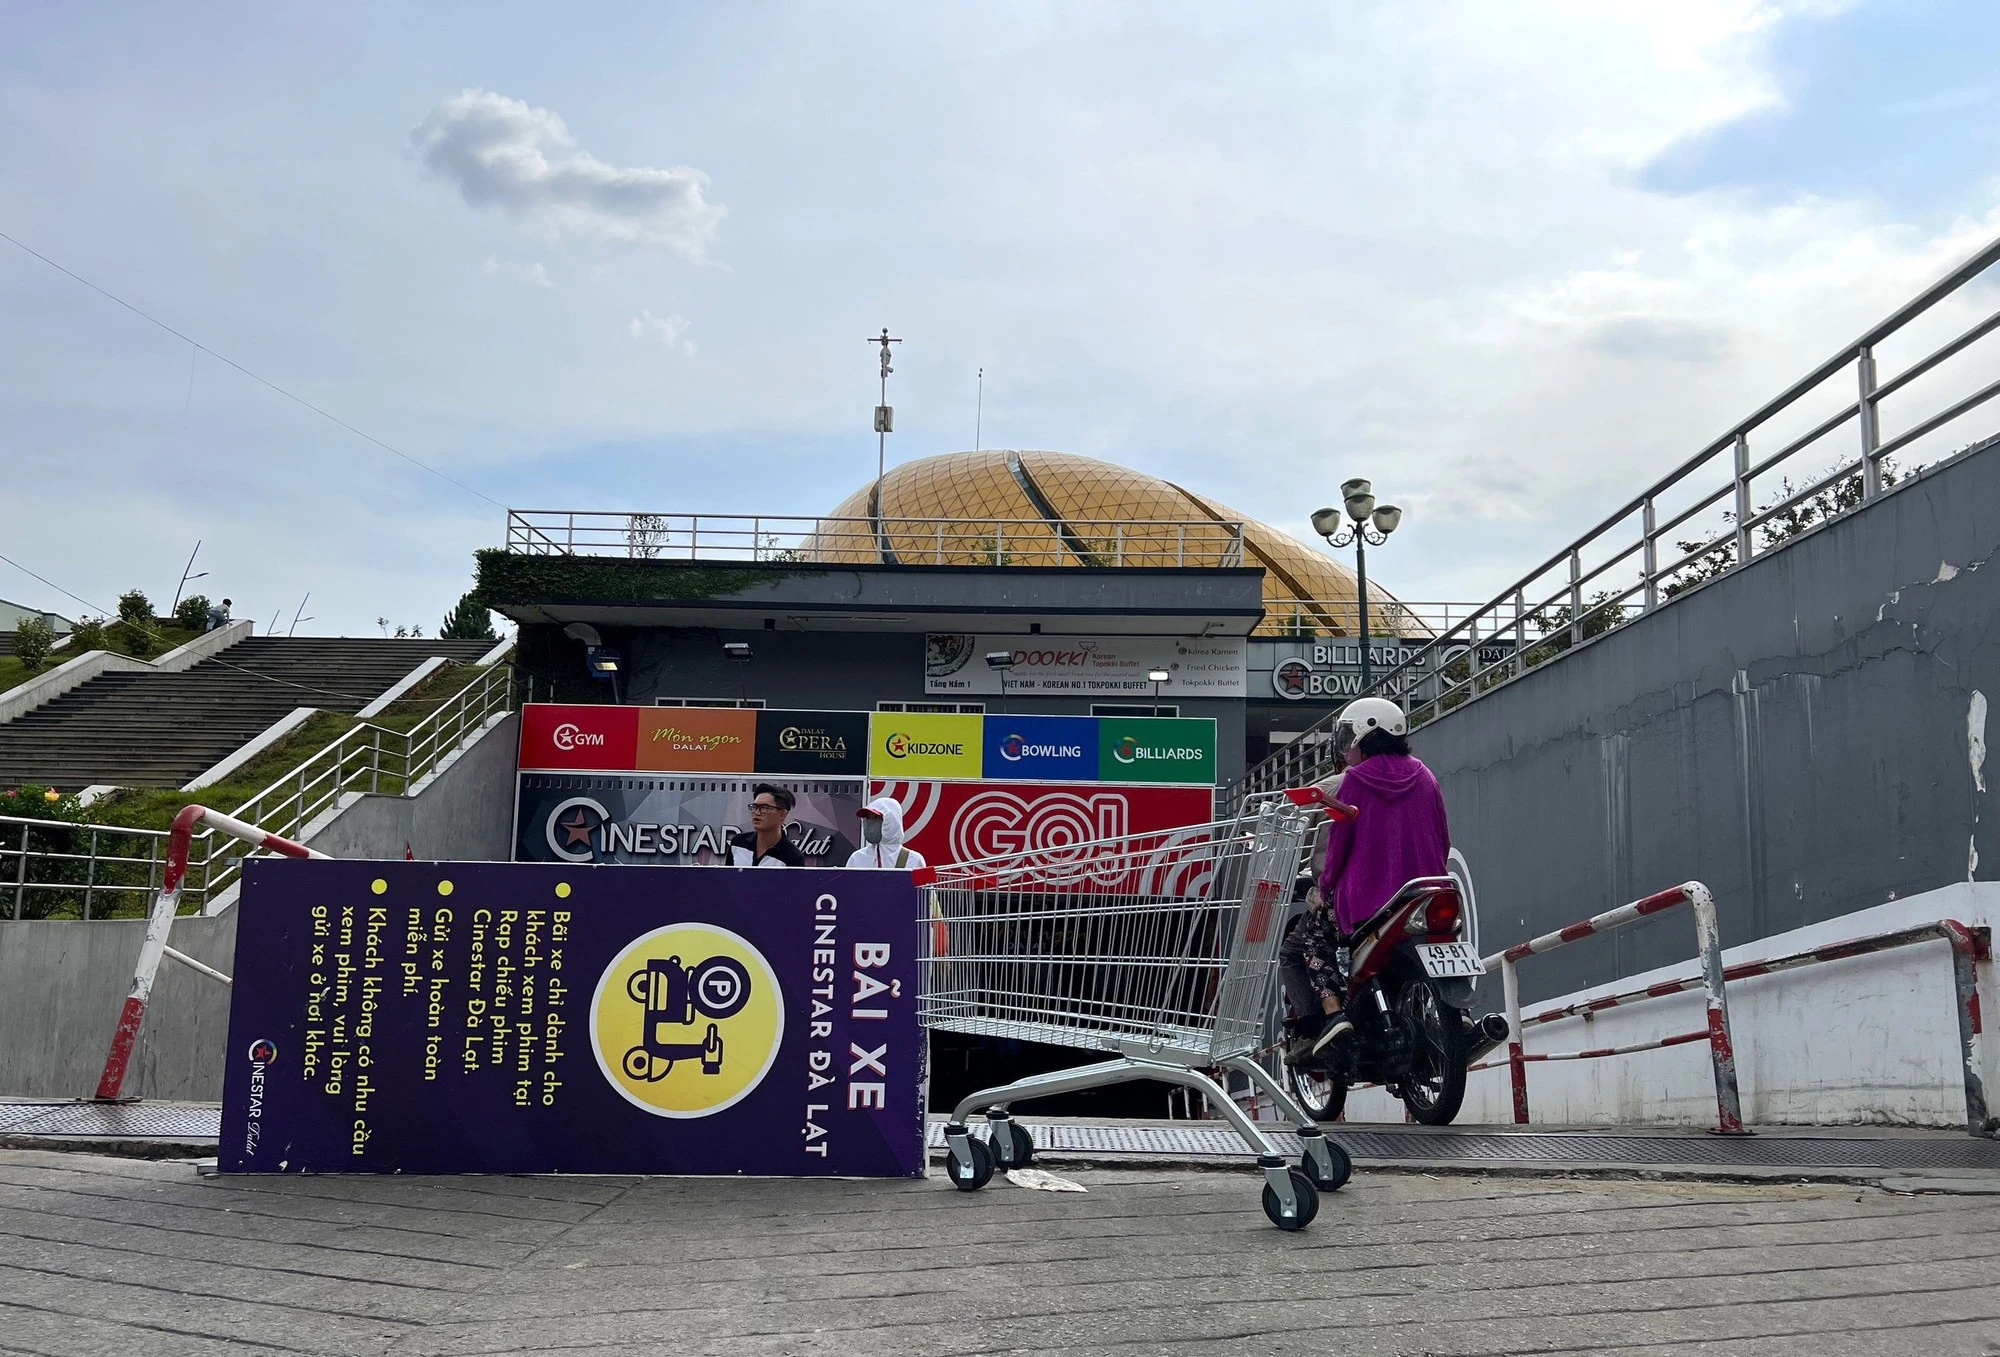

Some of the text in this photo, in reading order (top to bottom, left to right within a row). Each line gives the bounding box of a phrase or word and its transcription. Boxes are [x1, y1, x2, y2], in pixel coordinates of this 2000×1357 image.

[1012, 650, 1087, 668] DOOKKI
[1120, 660, 1140, 668] Buffet
[1188, 648, 1209, 656] Korea
[1004, 680, 1018, 689] VIET
[1020, 680, 1035, 689] NAM
[1042, 680, 1069, 689] KOREAN
[1071, 681, 1086, 689] NO.1
[1088, 681, 1121, 690] TOKPOKKI
[1123, 681, 1147, 690] BUFFET
[1181, 679, 1240, 688] Tokpokki Buffet
[673, 743, 708, 751] DALAT
[699, 735, 743, 751] ngon
[1021, 745, 1081, 758] BOWLING
[1135, 747, 1203, 760] BILLIARDS
[950, 791, 1128, 886] GO!
[401, 907, 428, 998] miễn phí.
[1428, 946, 1469, 959] 49-B1
[1429, 960, 1481, 974] 177.14
[303, 905, 330, 1081] gửi xe ở nơi khác.
[325, 905, 357, 1095] xem phim, vui lòng
[424, 908, 453, 1081] Gửi xe hoàn toàn
[462, 908, 492, 1075] Cinestar Đà Lạt.
[490, 910, 519, 1064] Rạp chiếu phim
[513, 910, 546, 1106] khách xem phim tại
[542, 911, 571, 1106] Bãi xe chỉ dành cho
[352, 907, 387, 1155] Khách không có nhu cầu
[801, 893, 838, 1157] CINESTAR ĐÀ LẠT
[847, 942, 901, 1111] BÃI XE
[245, 1122, 261, 1156] Dalat
